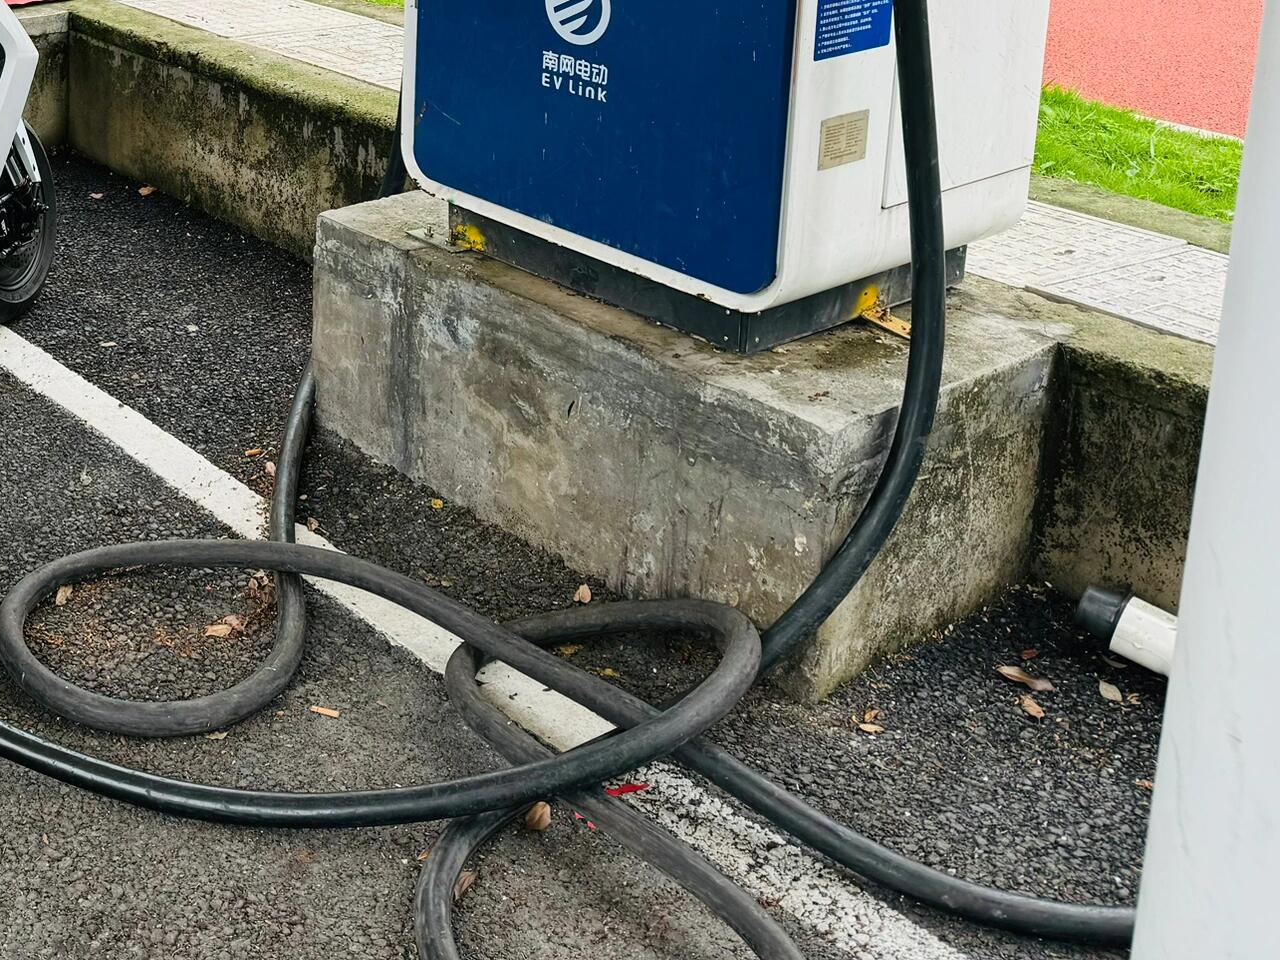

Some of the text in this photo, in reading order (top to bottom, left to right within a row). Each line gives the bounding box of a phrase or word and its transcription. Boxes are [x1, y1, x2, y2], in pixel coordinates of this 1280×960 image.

[542, 50, 608, 85] 南网电动
[541, 72, 608, 103] EV Link
